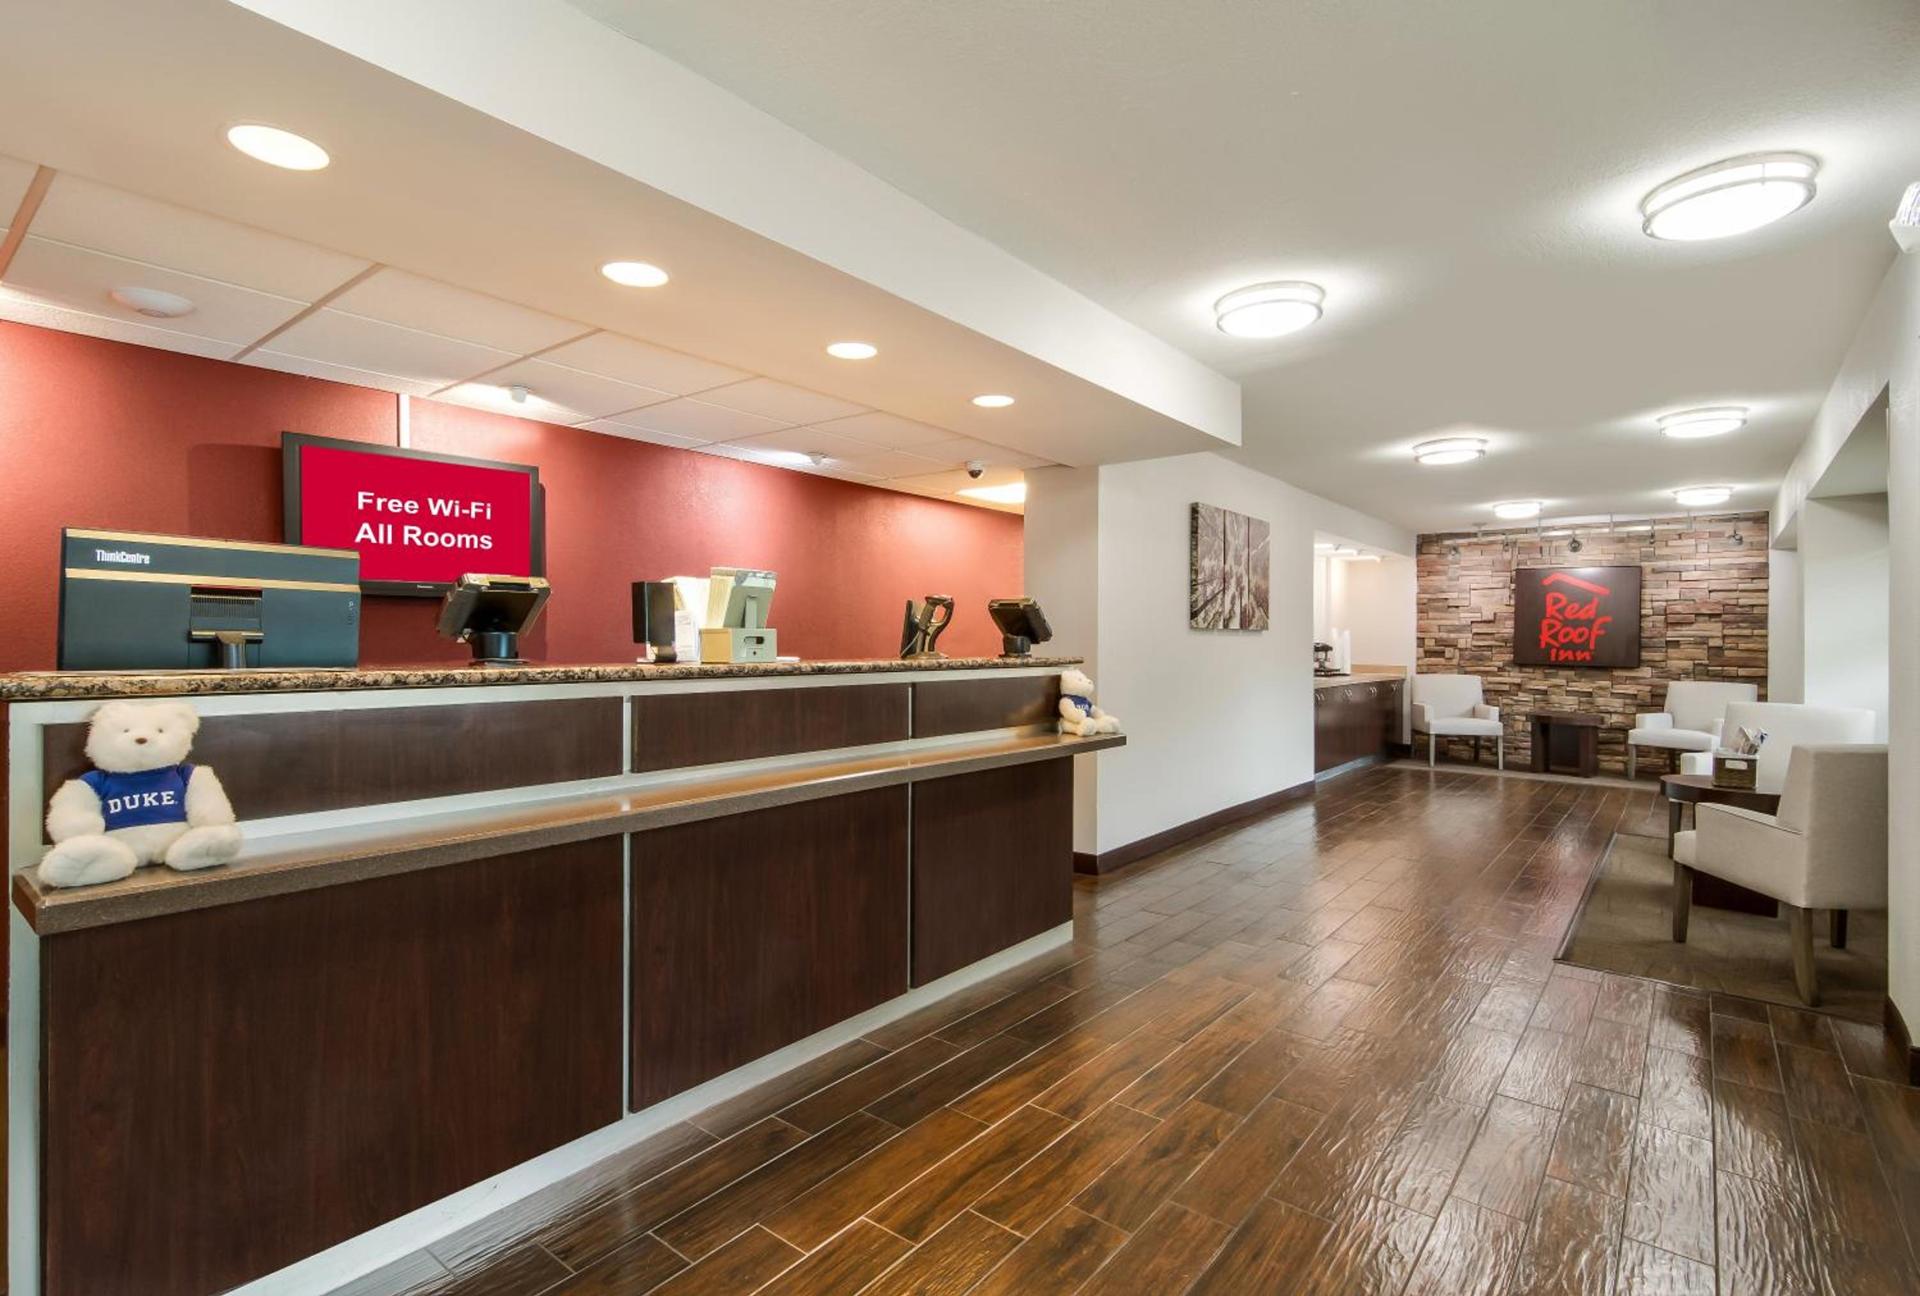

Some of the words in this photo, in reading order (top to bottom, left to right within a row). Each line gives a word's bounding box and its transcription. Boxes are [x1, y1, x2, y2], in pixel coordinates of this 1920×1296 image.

[357, 491, 419, 514] Free
[427, 498, 492, 520] Wi-Fi
[354, 522, 393, 545] All
[403, 525, 493, 549] Rooms
[95, 549, 150, 564] ThinkCentre
[1545, 592, 1599, 620] Red
[1539, 616, 1613, 650] Roof
[107, 790, 175, 814] DUKE
